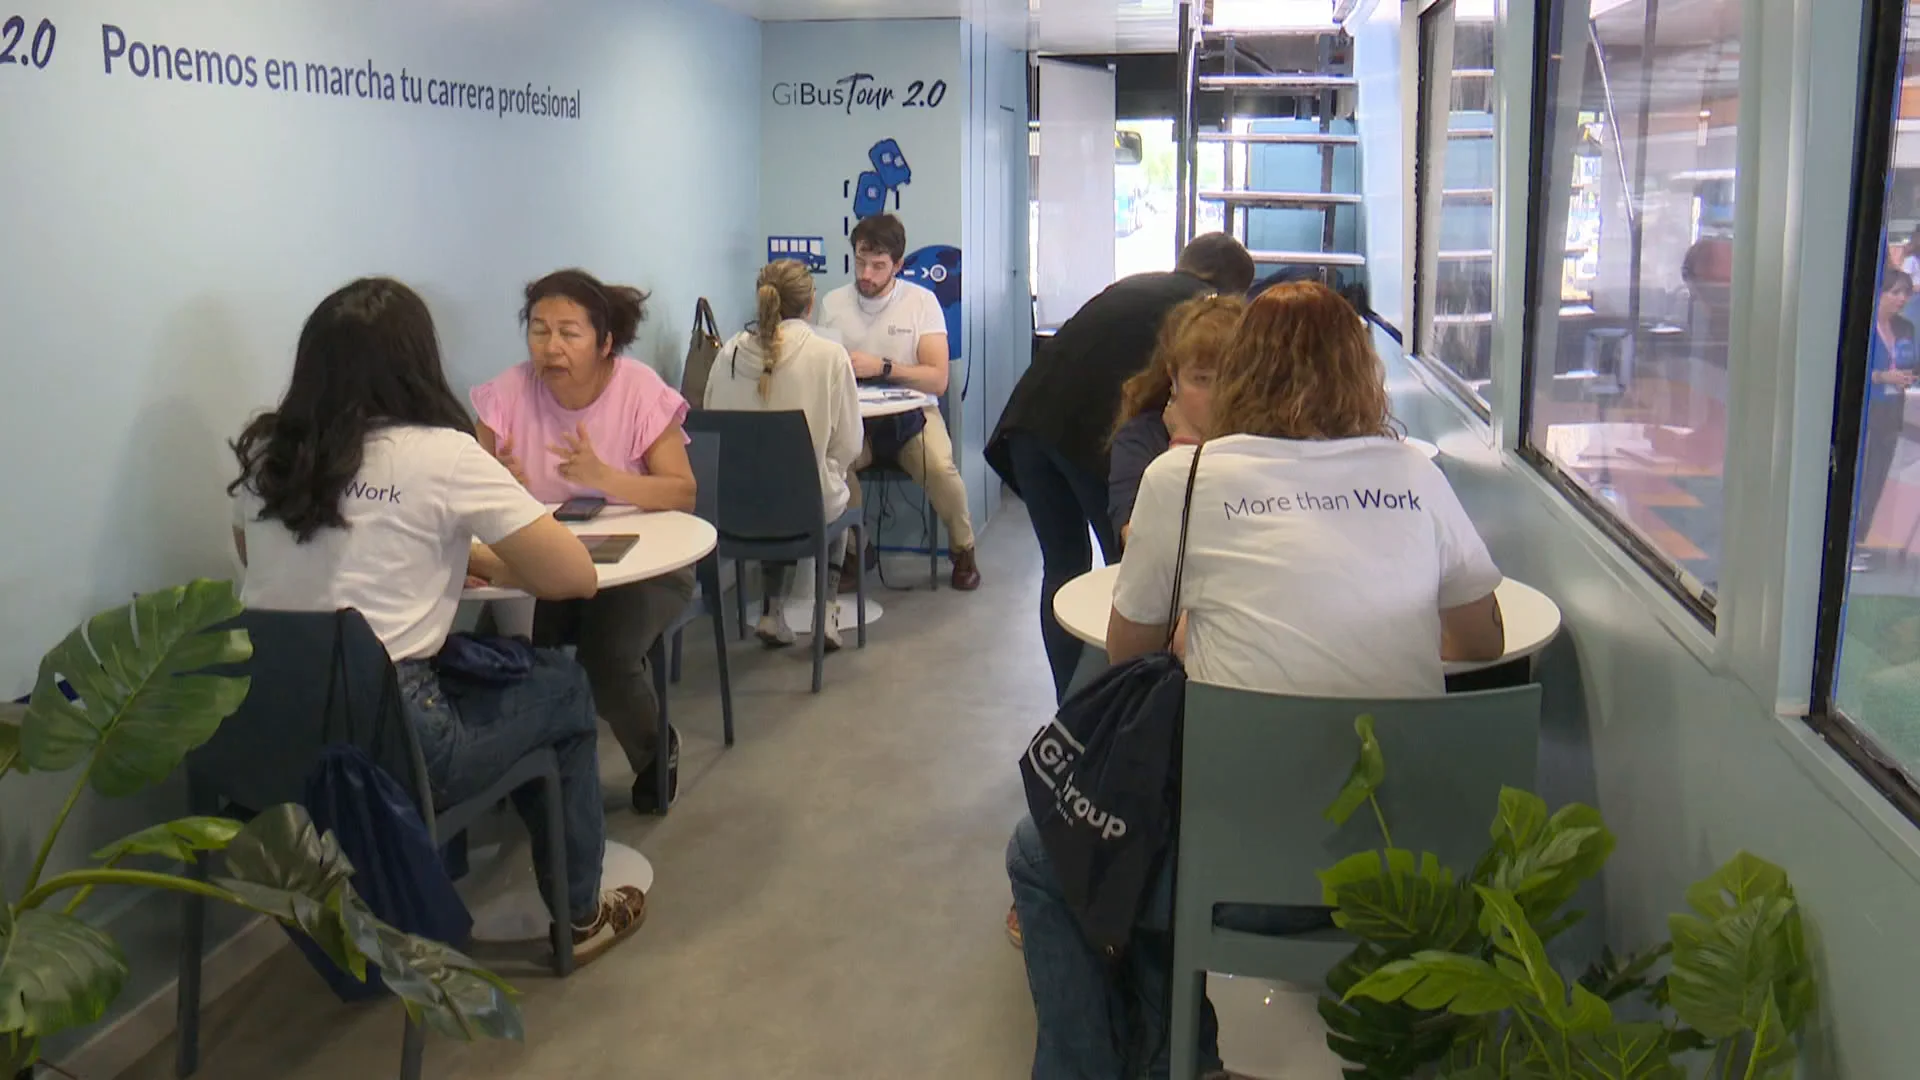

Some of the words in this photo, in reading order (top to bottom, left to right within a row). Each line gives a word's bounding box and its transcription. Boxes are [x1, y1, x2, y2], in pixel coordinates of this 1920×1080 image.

[0, 15, 56, 69] 2.0
[102, 23, 257, 89] Ponemos
[264, 57, 299, 92] en
[305, 60, 395, 102] marcha
[400, 67, 422, 104] tu
[427, 75, 495, 112] carrera
[498, 82, 581, 119] profesional
[902, 79, 947, 108] 2.0
[1224, 497, 1292, 521] More
[1296, 492, 1349, 511] than
[1353, 488, 1422, 511] Work
[1039, 738, 1074, 775] Gi
